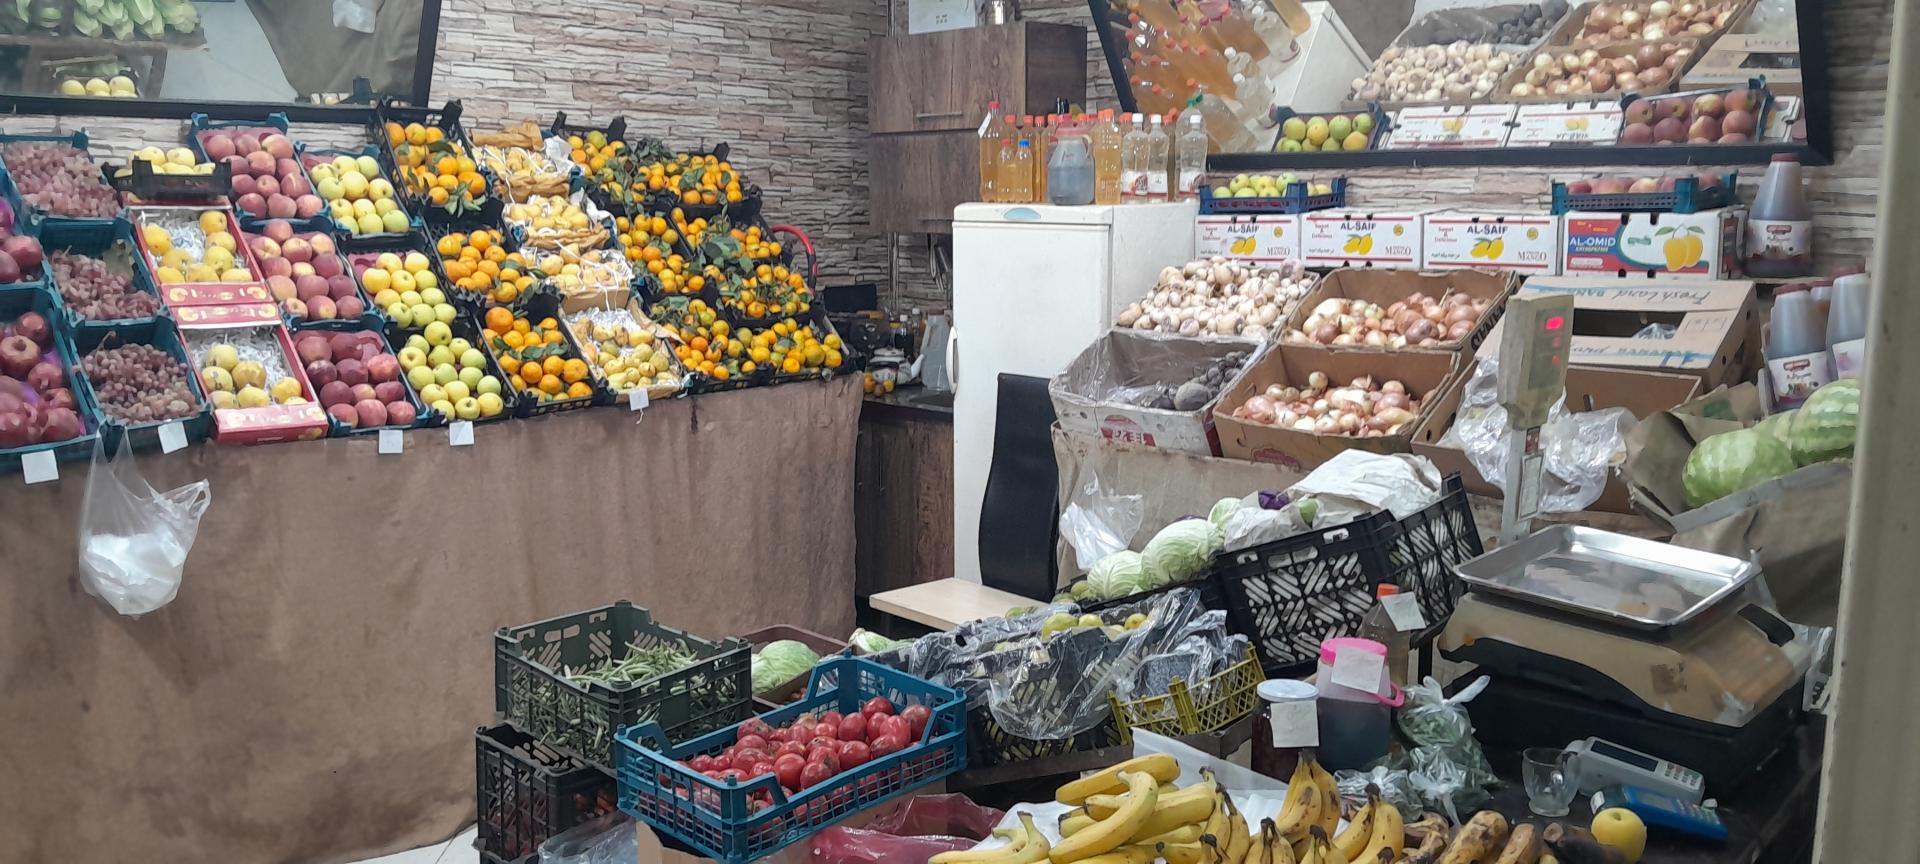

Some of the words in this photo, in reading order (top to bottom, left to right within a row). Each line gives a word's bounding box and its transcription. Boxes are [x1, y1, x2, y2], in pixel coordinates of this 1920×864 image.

[1228, 224, 1259, 233] AL-SAIF
[1340, 222, 1376, 231] AL-SAIF
[1467, 224, 1508, 235] AL-SAIF
[1569, 236, 1616, 247] AL-OMID
[1612, 290, 1658, 302] Land
[1663, 291, 1711, 305] Fresh
